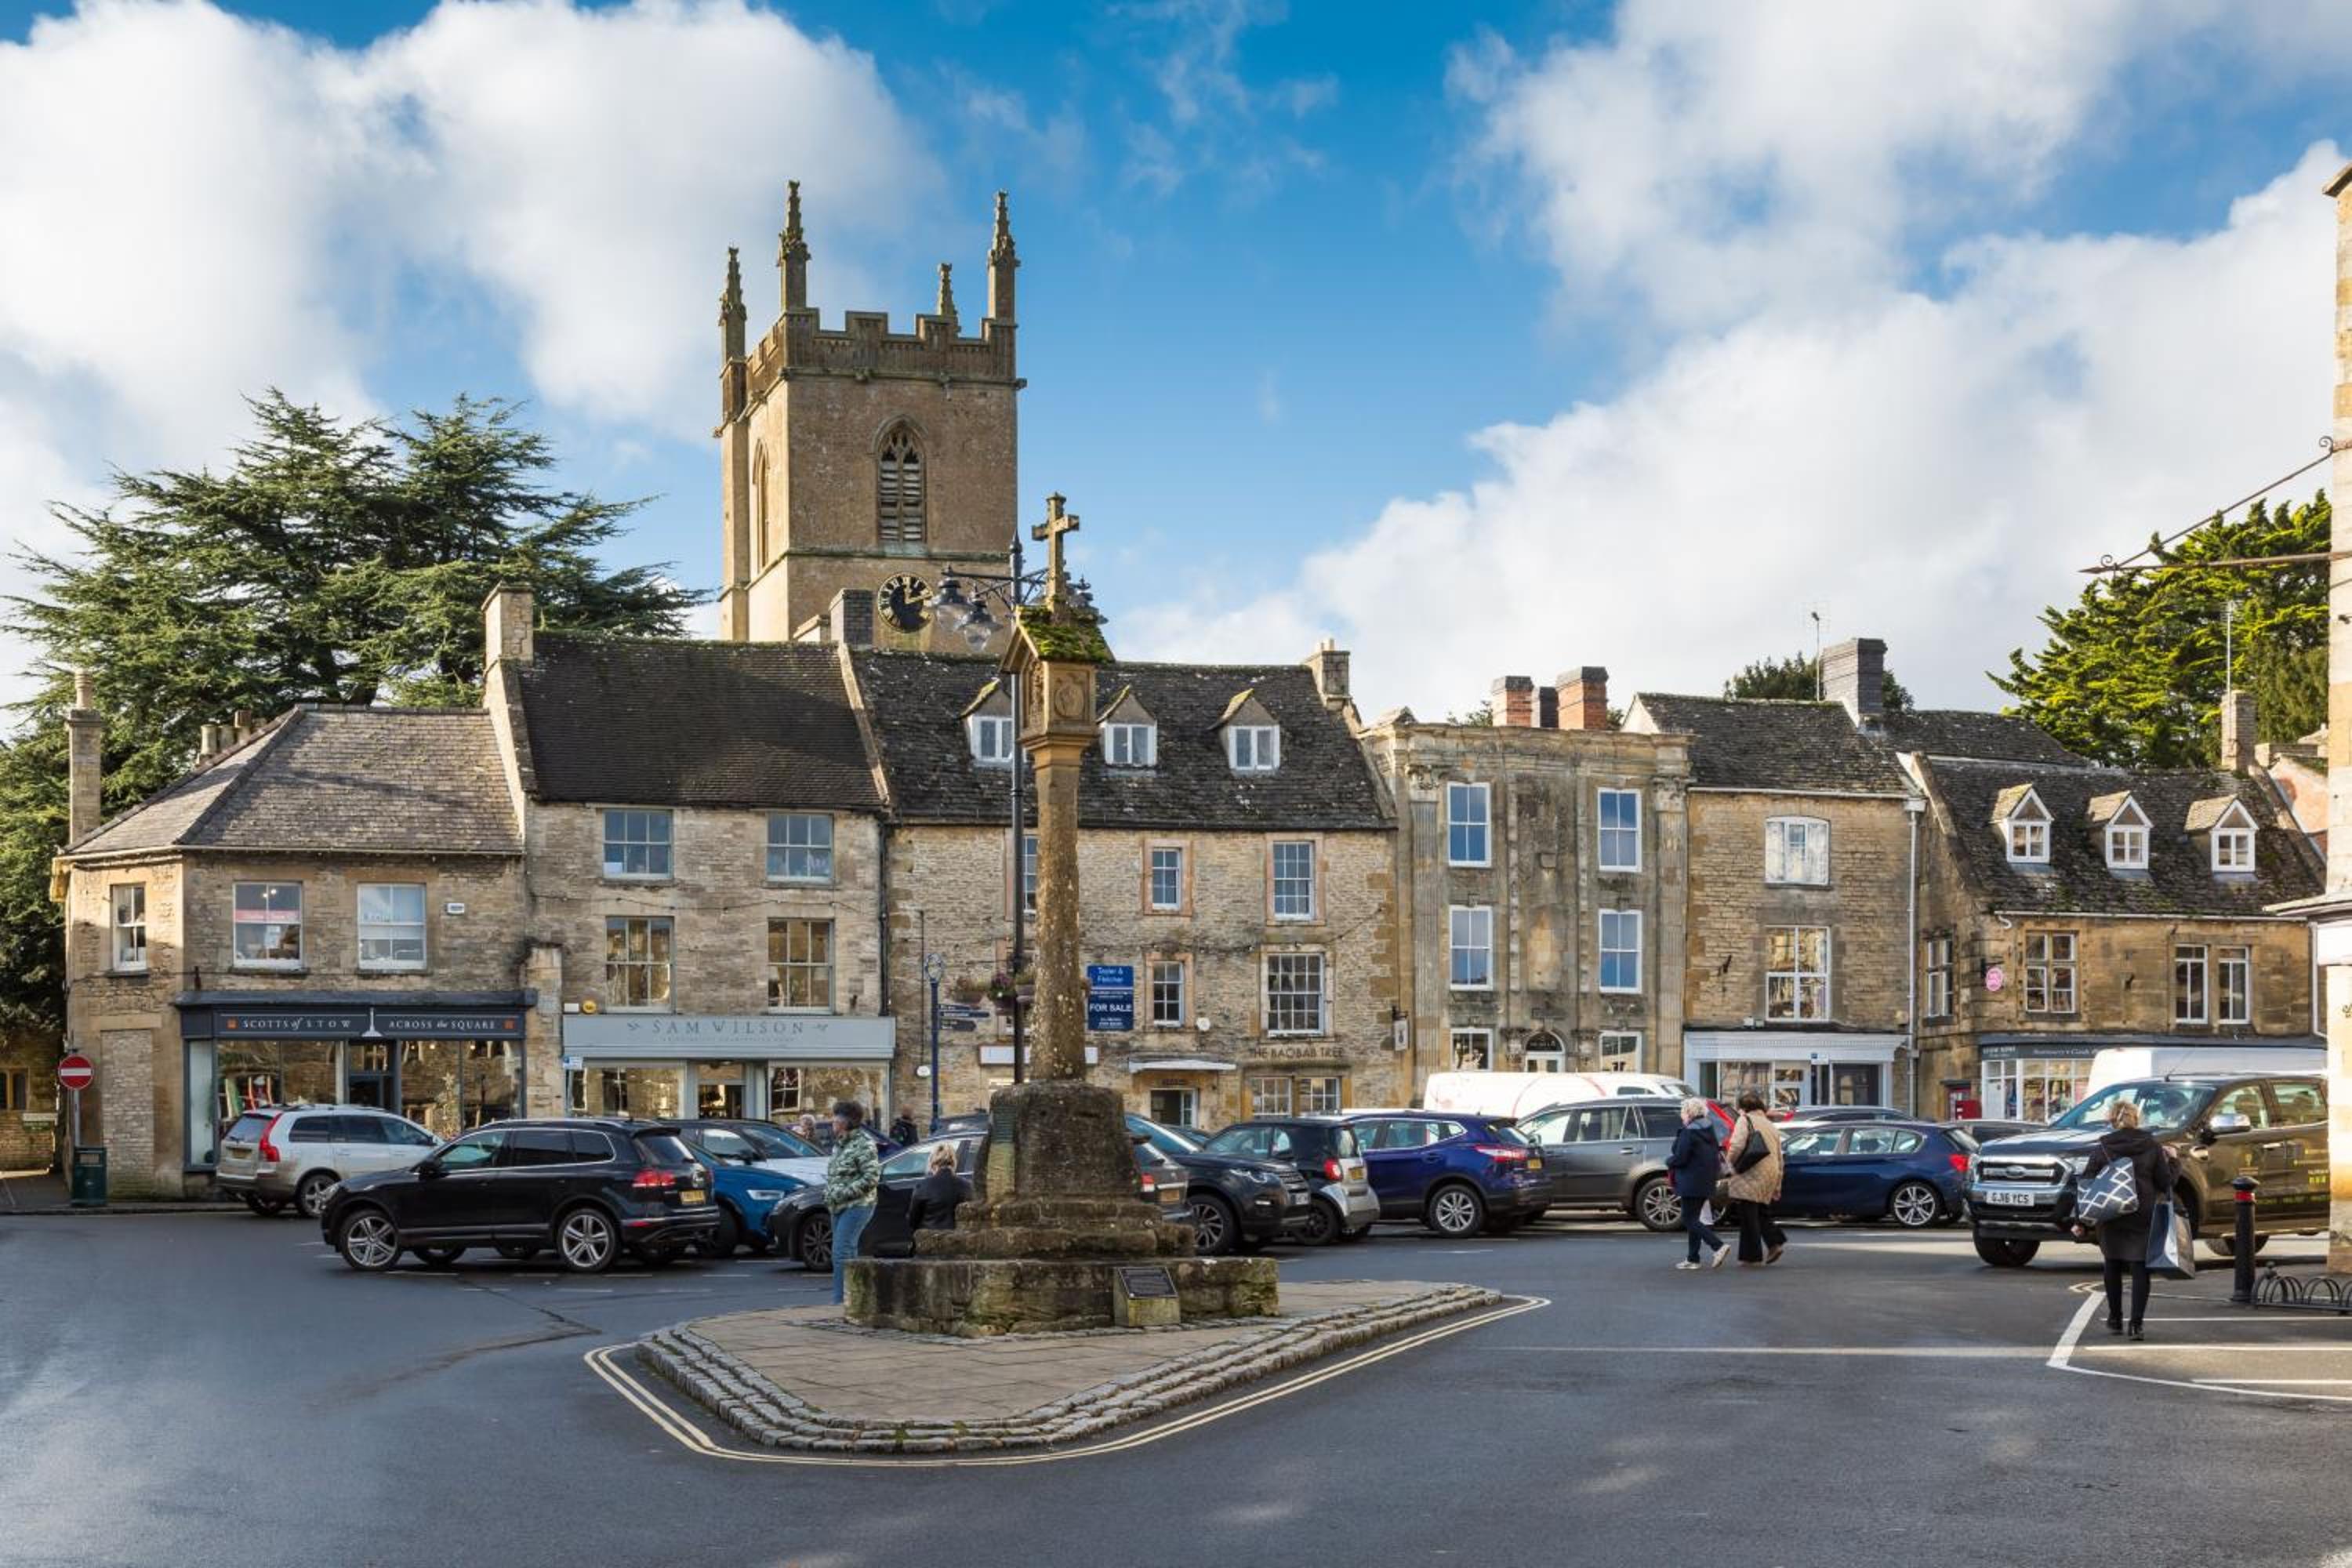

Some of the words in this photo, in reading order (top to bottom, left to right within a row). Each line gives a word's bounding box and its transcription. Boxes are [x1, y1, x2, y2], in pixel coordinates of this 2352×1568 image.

[1089, 1004, 1108, 1012] FOR
[1109, 1004, 1133, 1012] SALE
[242, 1019, 289, 1029] SCOTTS
[307, 1019, 351, 1029] STOW
[388, 1019, 433, 1029] ACROSS
[436, 1019, 448, 1029] the
[450, 1019, 495, 1030] SQUARE
[652, 1019, 699, 1034] SAM
[712, 1020, 804, 1034] WILSON
[1271, 1047, 1317, 1058] BAOBAB
[1320, 1047, 1343, 1058] TREE
